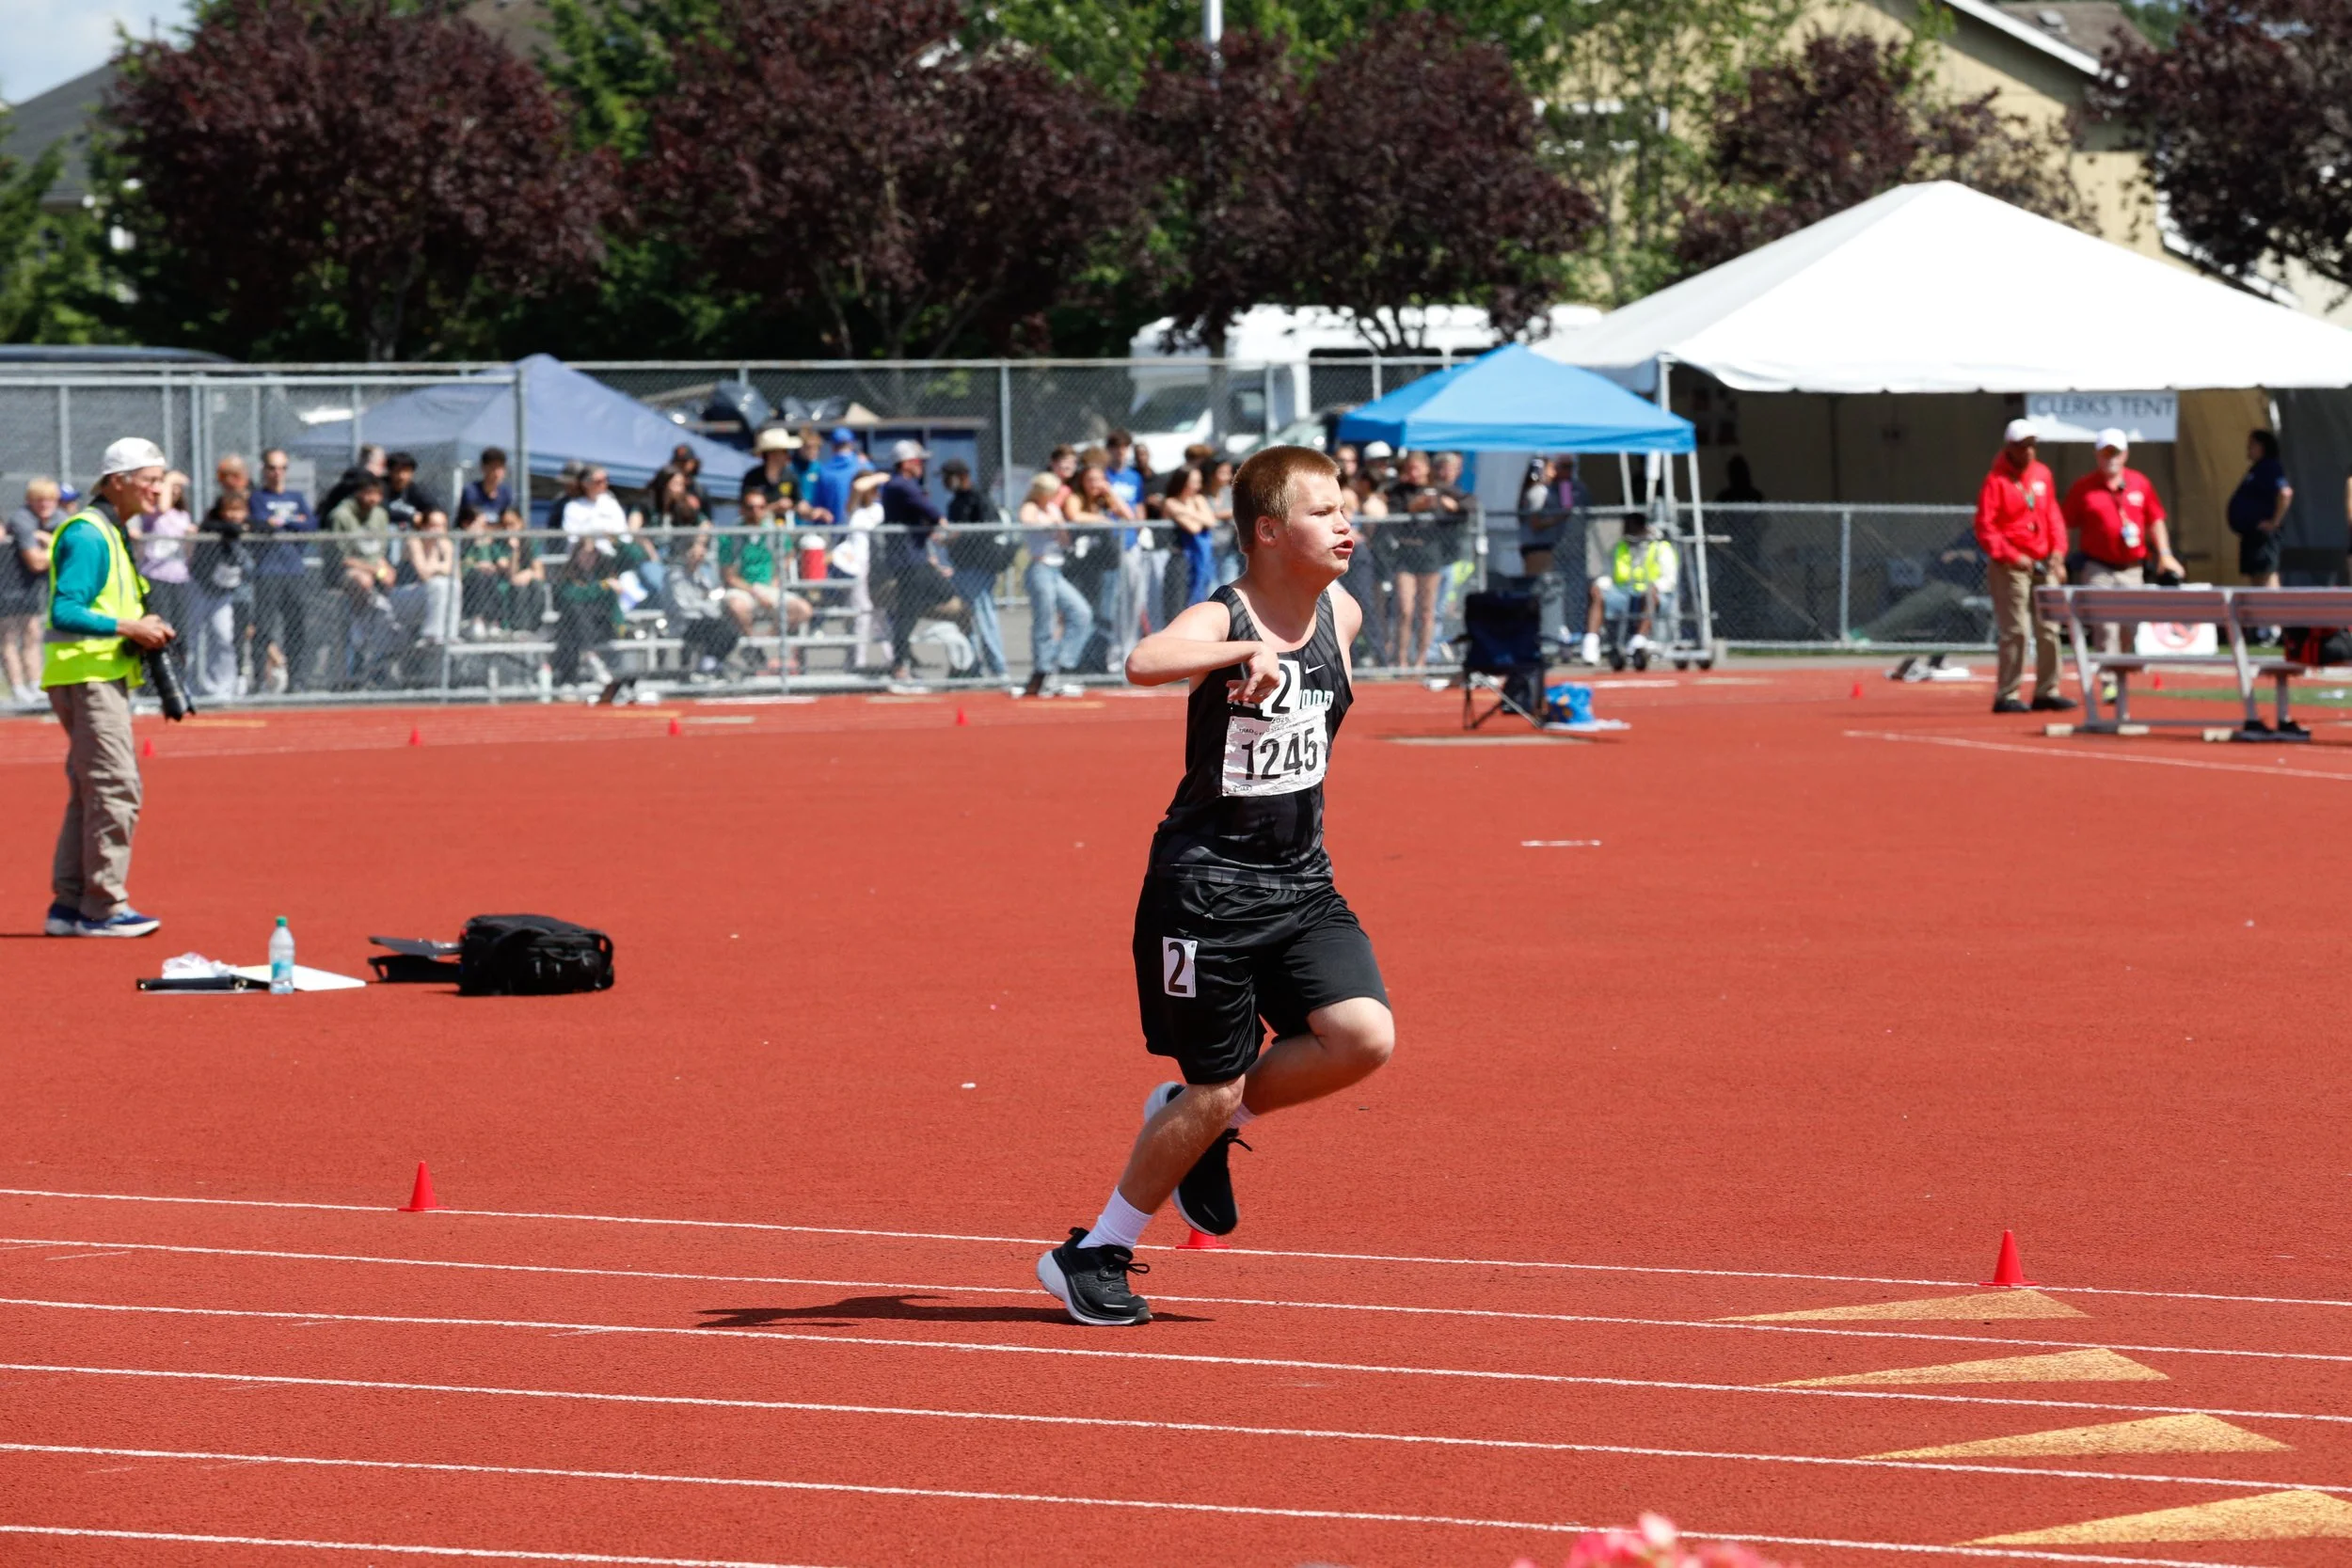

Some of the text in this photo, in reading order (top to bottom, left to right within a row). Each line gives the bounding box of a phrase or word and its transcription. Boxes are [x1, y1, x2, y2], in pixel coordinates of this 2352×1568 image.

[2034, 394, 2173, 419] CLERKS TENT
[1271, 662, 1292, 715] 2
[1241, 726, 1318, 781] 1245
[1168, 941, 1188, 994] 2
